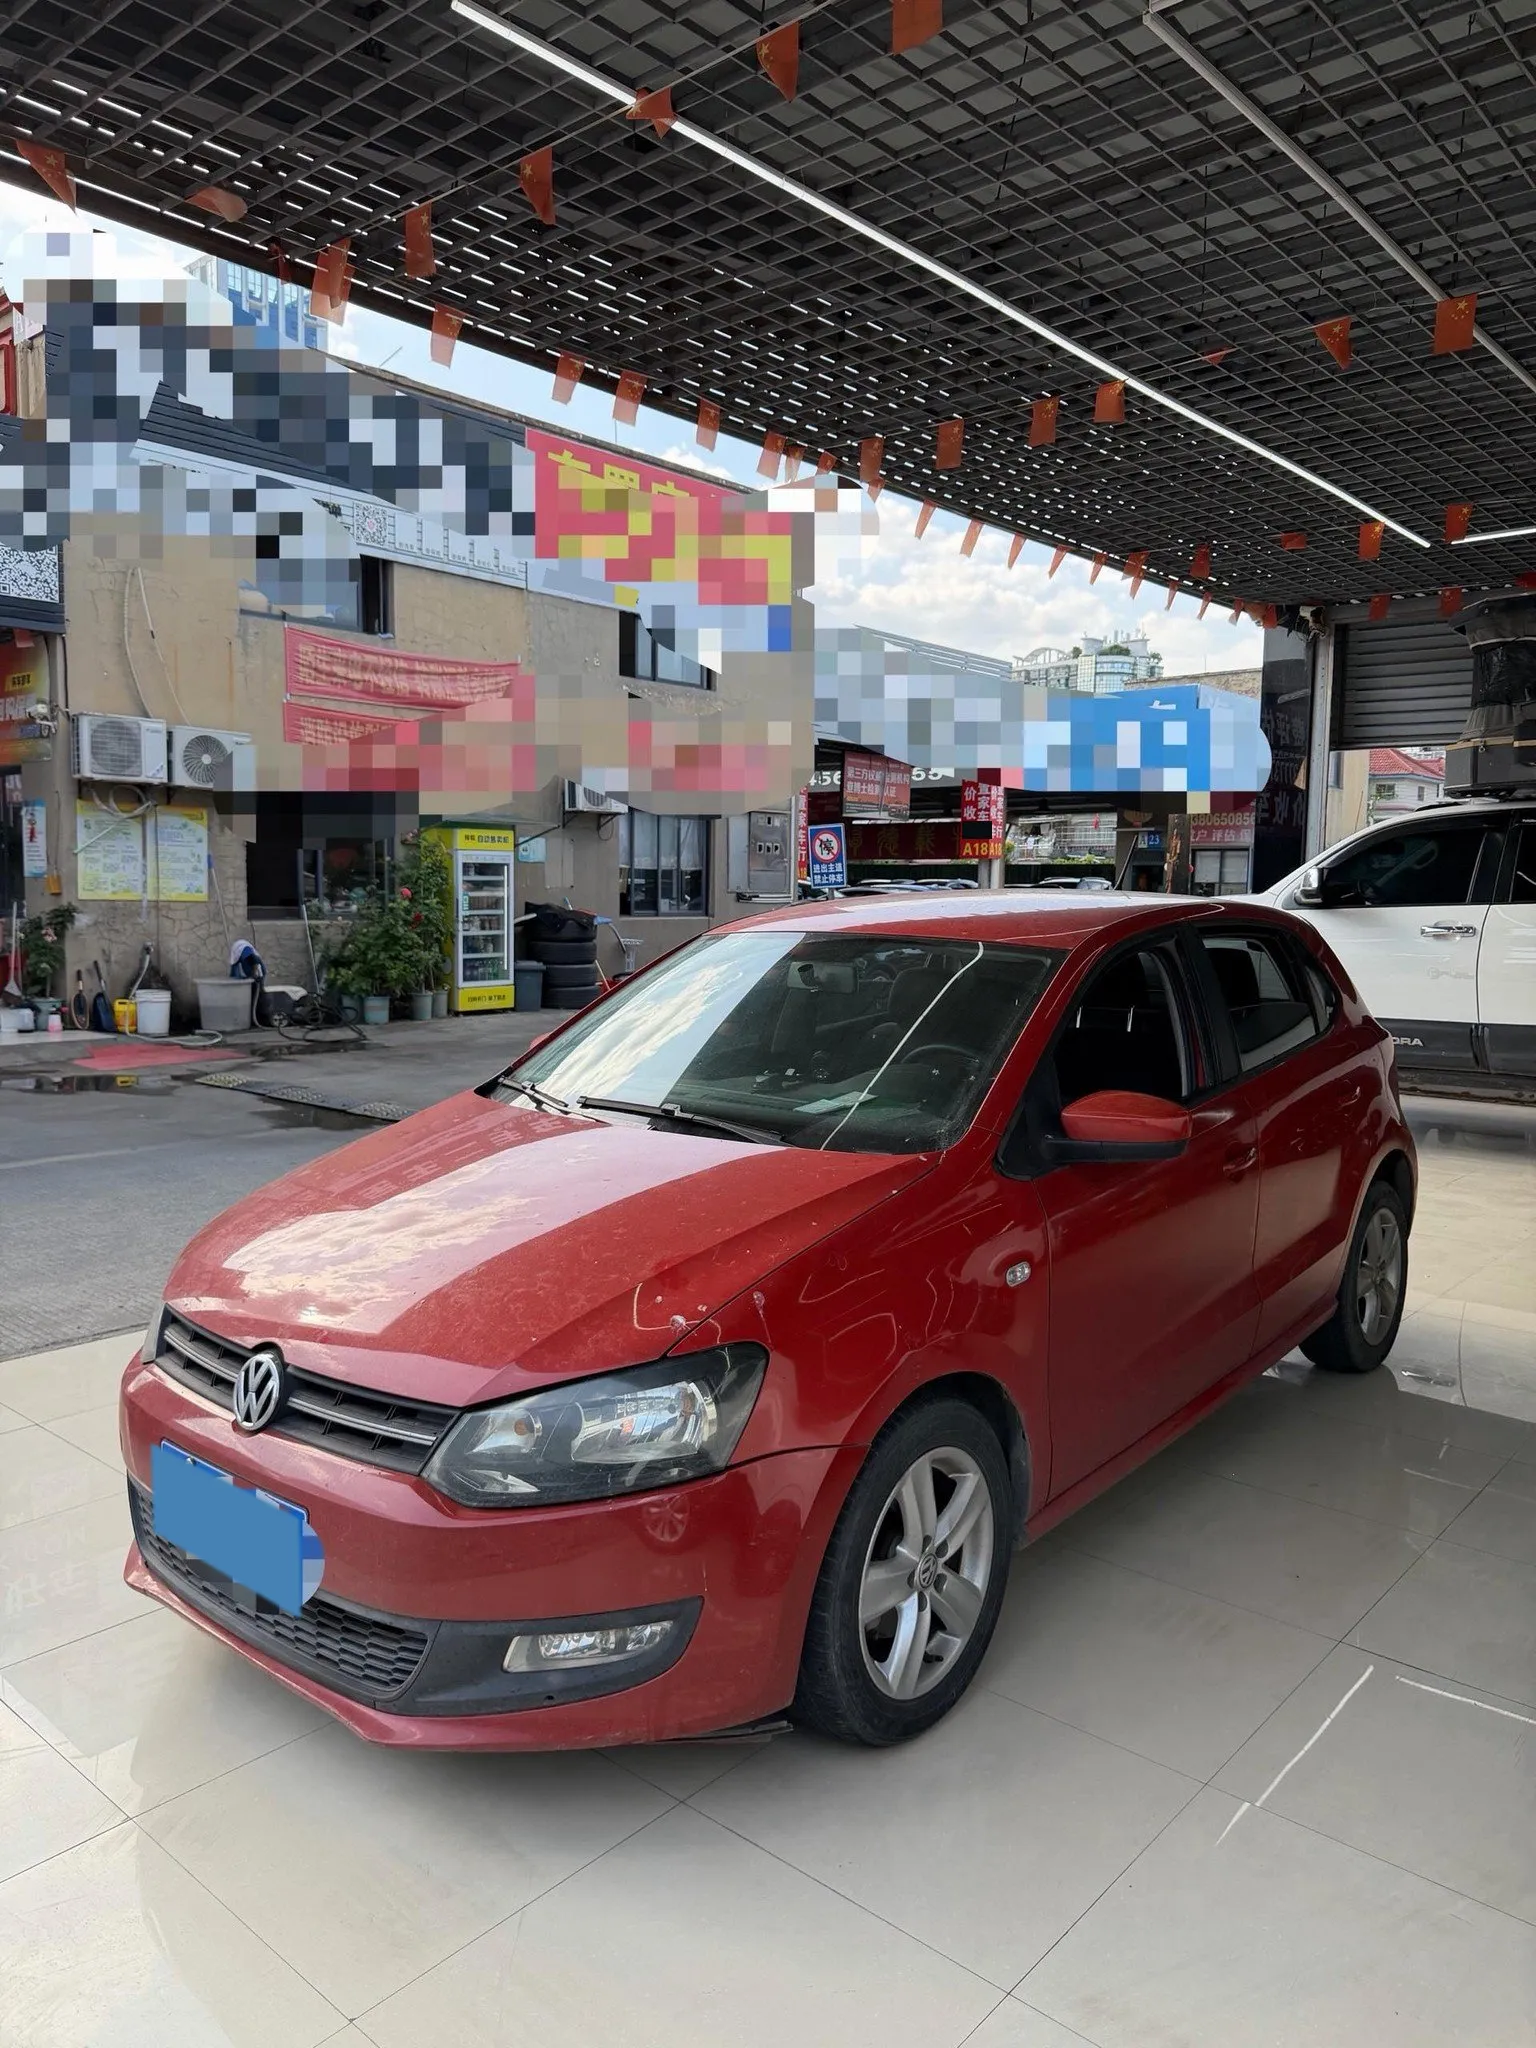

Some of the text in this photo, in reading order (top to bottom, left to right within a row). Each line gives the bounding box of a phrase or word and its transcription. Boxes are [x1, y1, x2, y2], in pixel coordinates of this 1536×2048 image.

[962, 842, 988, 856] A18
[813, 873, 844, 884] 禁止停车
